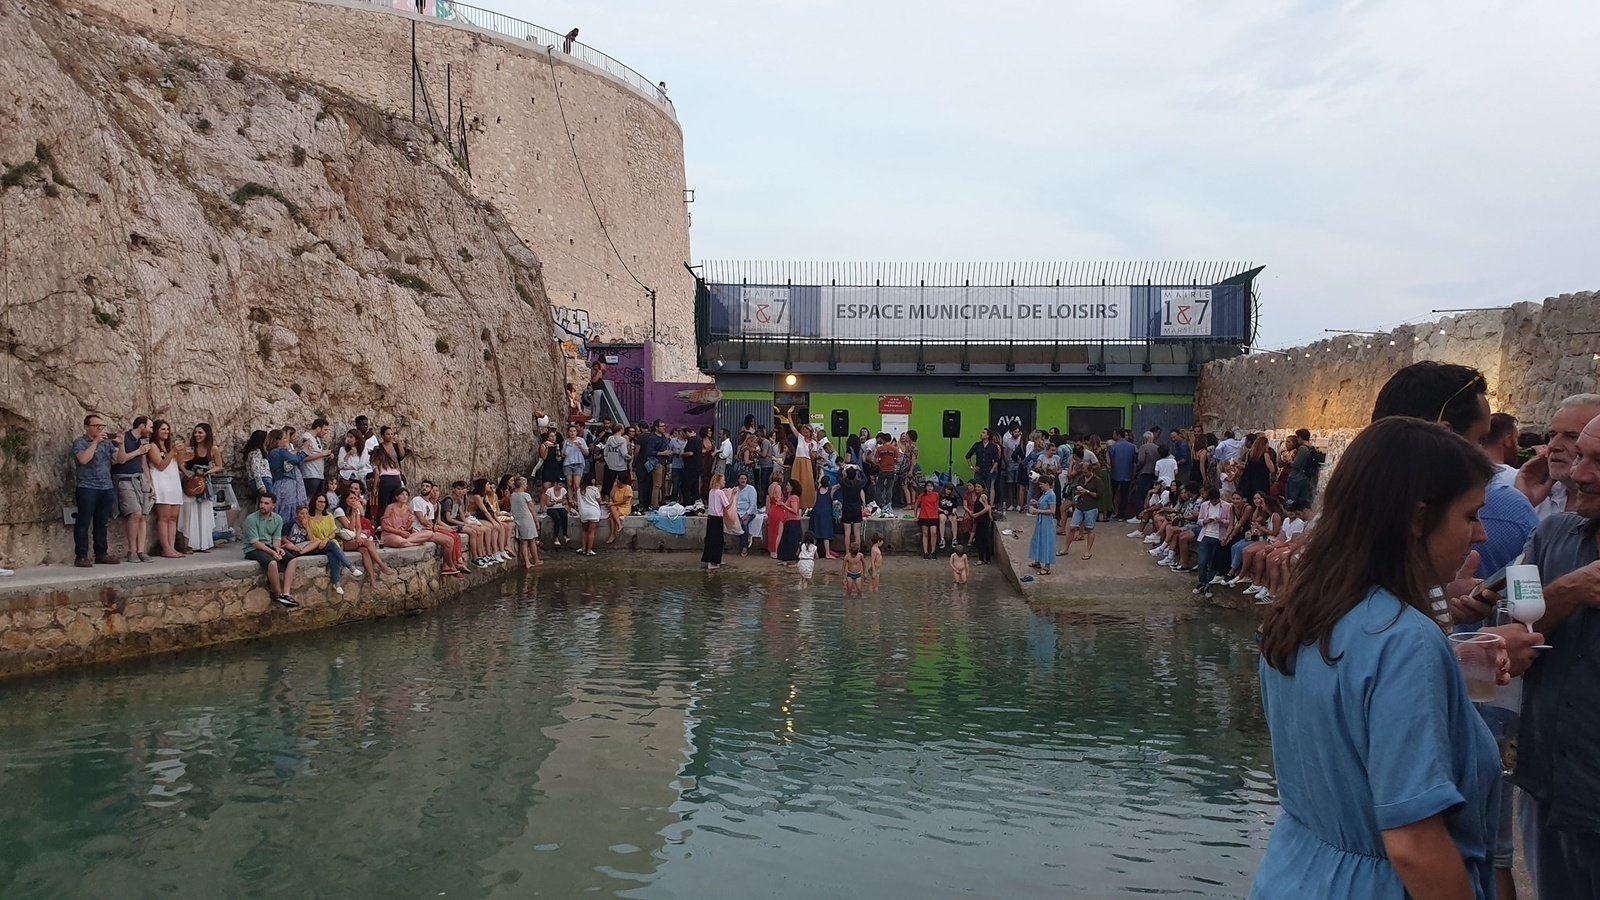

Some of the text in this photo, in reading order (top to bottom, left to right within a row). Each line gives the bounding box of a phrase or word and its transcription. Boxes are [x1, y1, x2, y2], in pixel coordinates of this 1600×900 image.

[743, 290, 788, 298] MAIRIE
[836, 303, 1119, 319] ESPACE MUNICIPAL DE LOISIRS
[997, 415, 1022, 426] AVA
